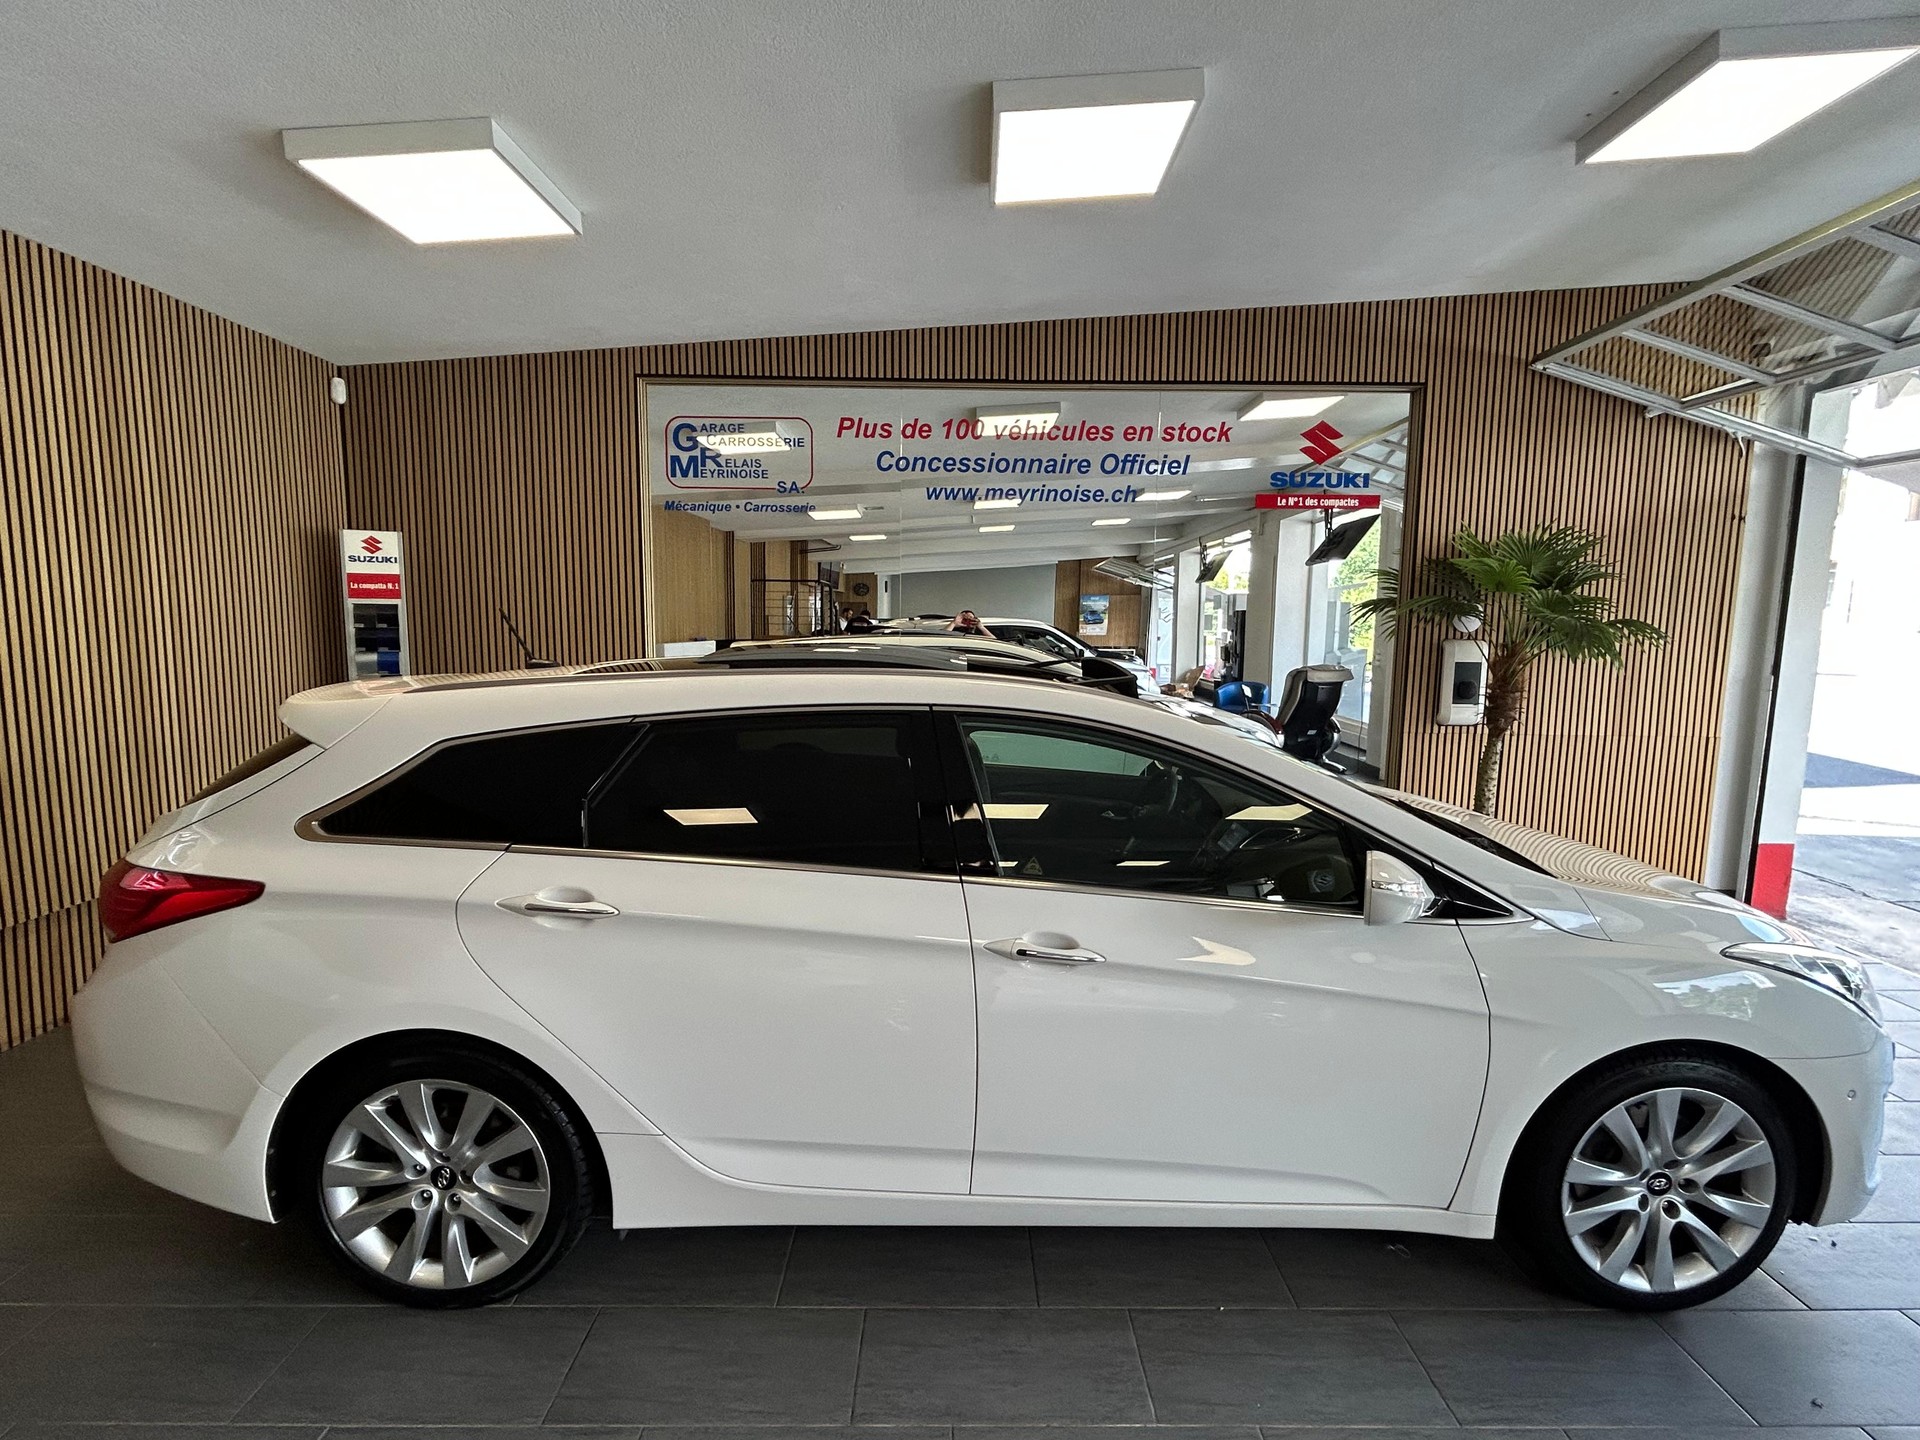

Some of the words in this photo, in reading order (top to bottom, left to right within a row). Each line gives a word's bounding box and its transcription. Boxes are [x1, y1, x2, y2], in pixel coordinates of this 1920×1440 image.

[836, 416, 893, 439] Plus
[901, 417, 932, 439] de
[942, 418, 985, 440] 100
[994, 418, 1115, 441] véhicules
[1122, 424, 1153, 442] en
[1161, 421, 1233, 442] stock
[706, 434, 805, 448] CARROSSERIE
[876, 450, 1092, 474] Concessionnaire
[1100, 453, 1190, 475] Officiel
[1270, 471, 1370, 489] SUZUKI
[776, 481, 805, 495] SA.
[926, 484, 1138, 506] www.meyrinoise.ch
[664, 500, 732, 515] Mécanique
[743, 501, 816, 514] Carrosserie
[1277, 496, 1286, 507] Le
[1305, 497, 1318, 506] des
[1320, 497, 1359, 508] compactes
[348, 555, 398, 564] SUZUKI
